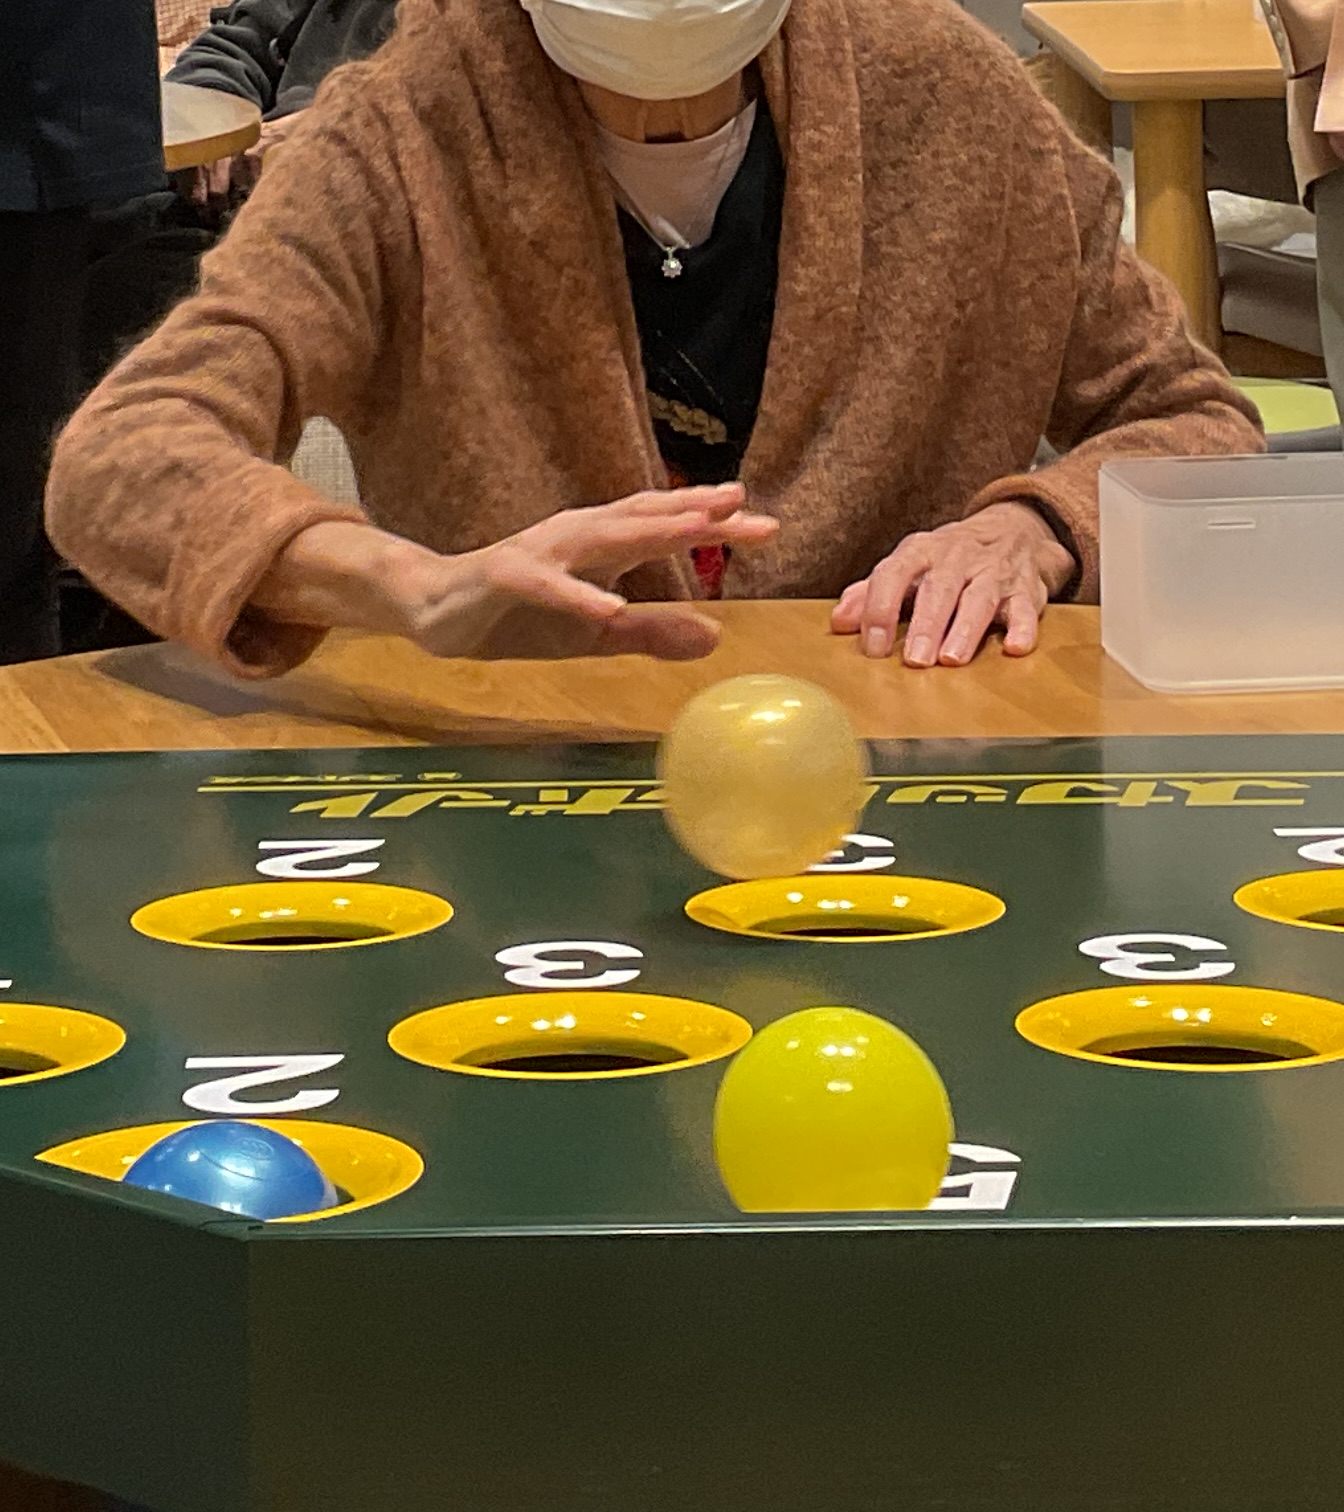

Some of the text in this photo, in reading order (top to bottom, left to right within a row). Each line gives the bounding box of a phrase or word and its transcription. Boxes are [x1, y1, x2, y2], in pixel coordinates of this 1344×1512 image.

[289, 780, 1312, 818] スカッボール
[255, 838, 386, 879] 2
[494, 941, 644, 988] 3
[1078, 933, 1236, 981] 3
[181, 1053, 346, 1115] 2
